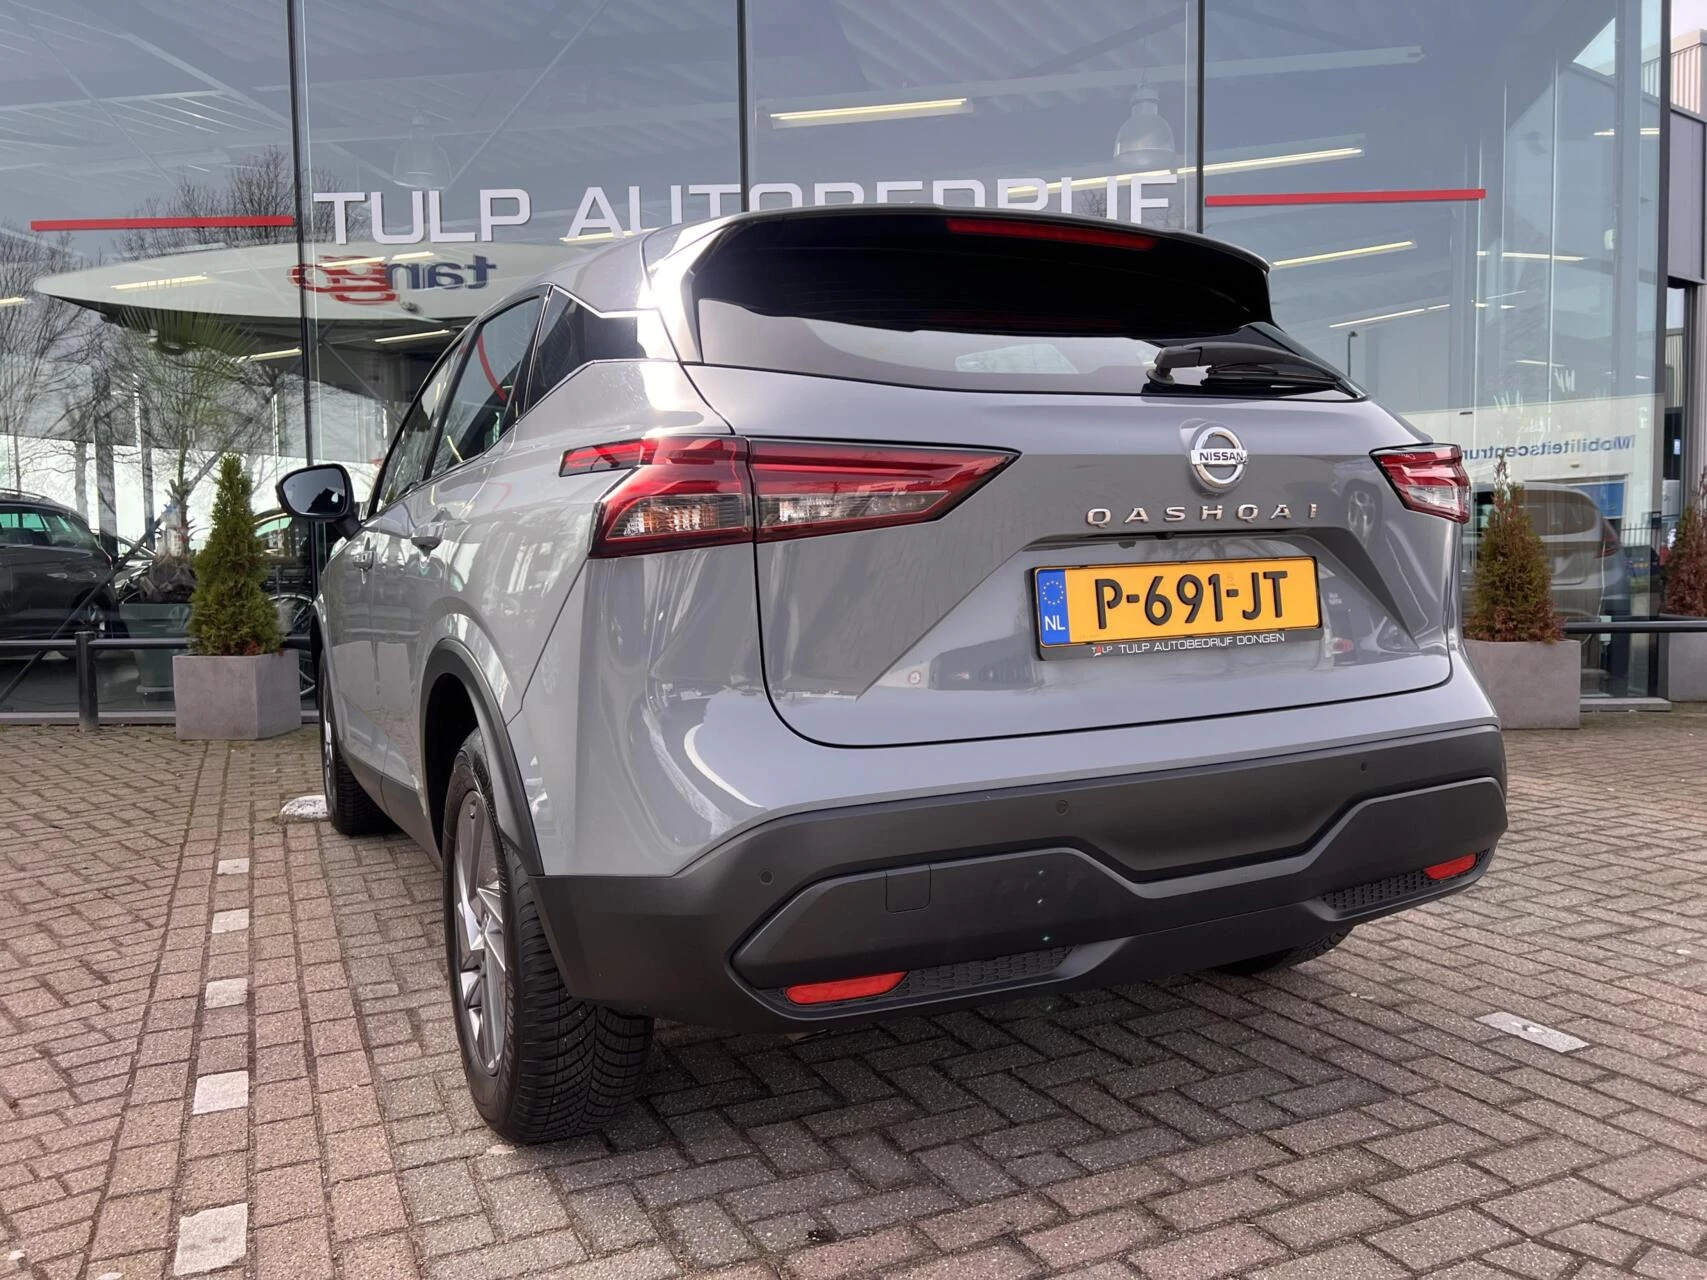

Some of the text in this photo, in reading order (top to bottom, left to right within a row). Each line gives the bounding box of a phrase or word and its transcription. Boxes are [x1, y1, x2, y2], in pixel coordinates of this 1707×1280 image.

[314, 188, 532, 245] TULP
[1199, 451, 1244, 462] NISSAN
[1086, 503, 1318, 528] QASHQAI
[1094, 571, 1288, 630] P-691-JT
[1044, 615, 1067, 632] NL
[1119, 633, 1286, 655] TULP AUTOBEDRIJF DONGEN
